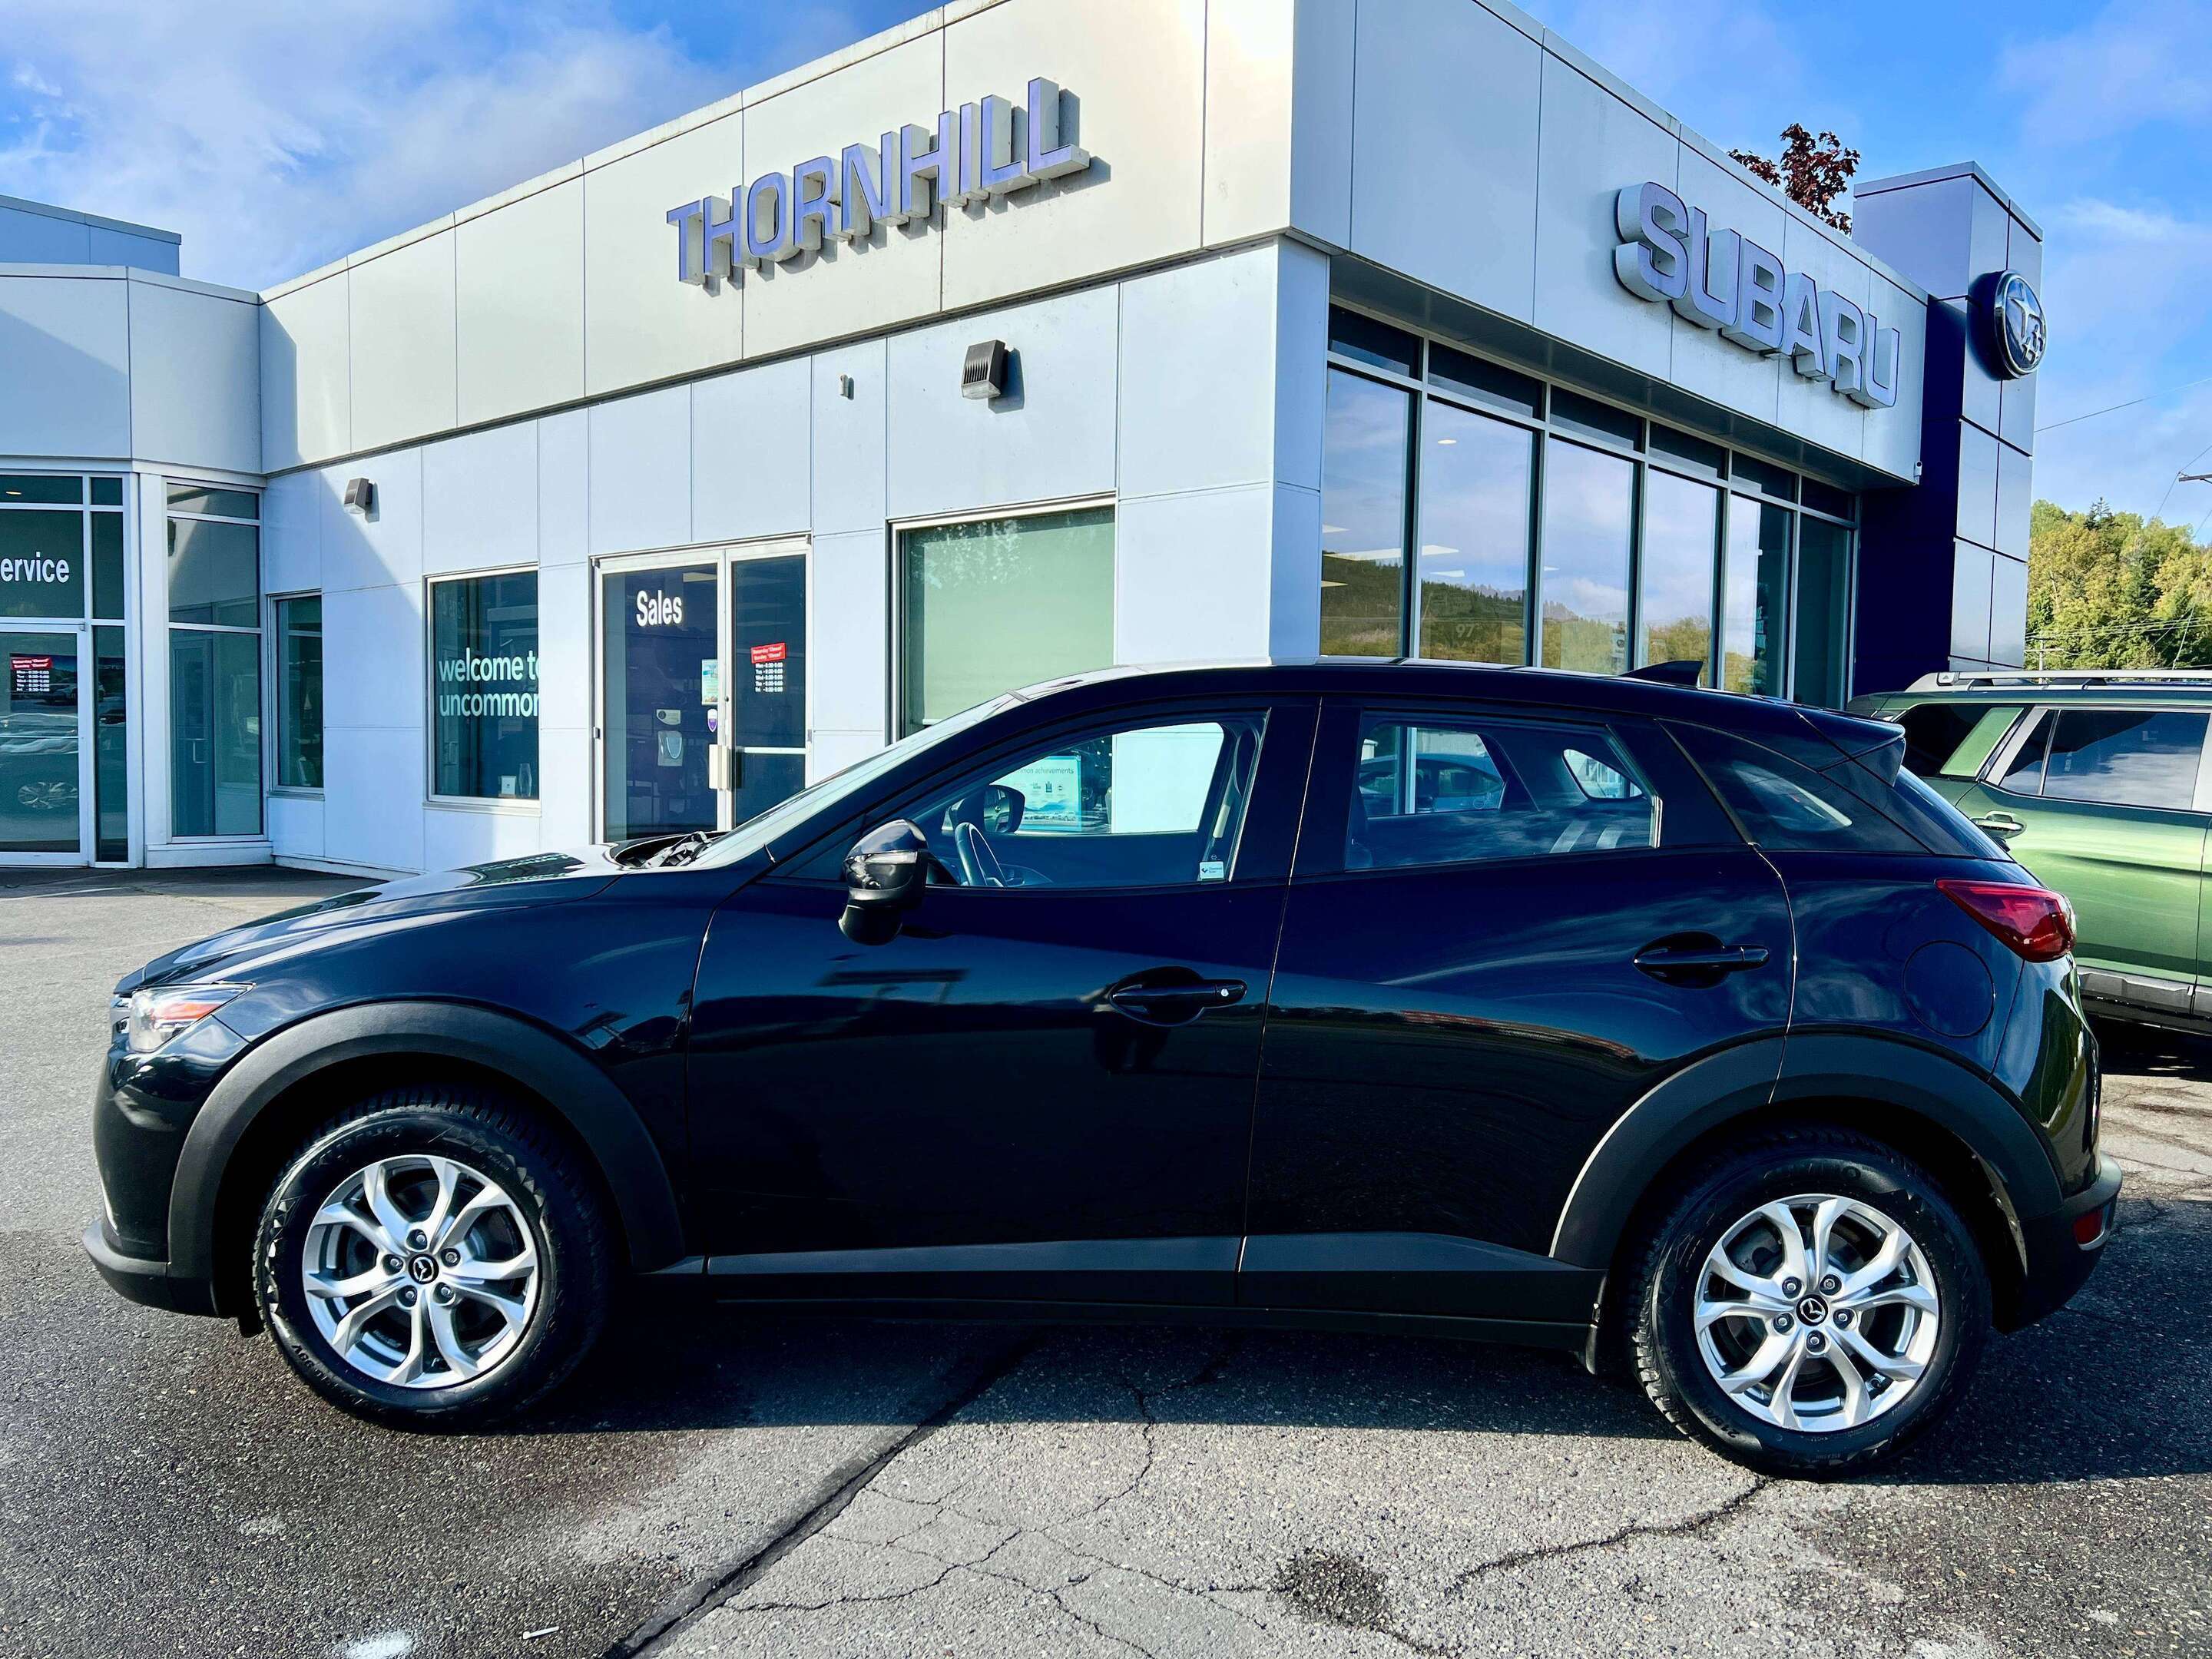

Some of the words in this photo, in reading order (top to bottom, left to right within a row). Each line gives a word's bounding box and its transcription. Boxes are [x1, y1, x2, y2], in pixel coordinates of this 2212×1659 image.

[666, 77, 1090, 286] THORNHILL
[1614, 182, 1902, 409] SUBARU
[0, 551, 70, 583] ervice
[636, 590, 682, 627] Sales
[439, 647, 525, 682] welcome
